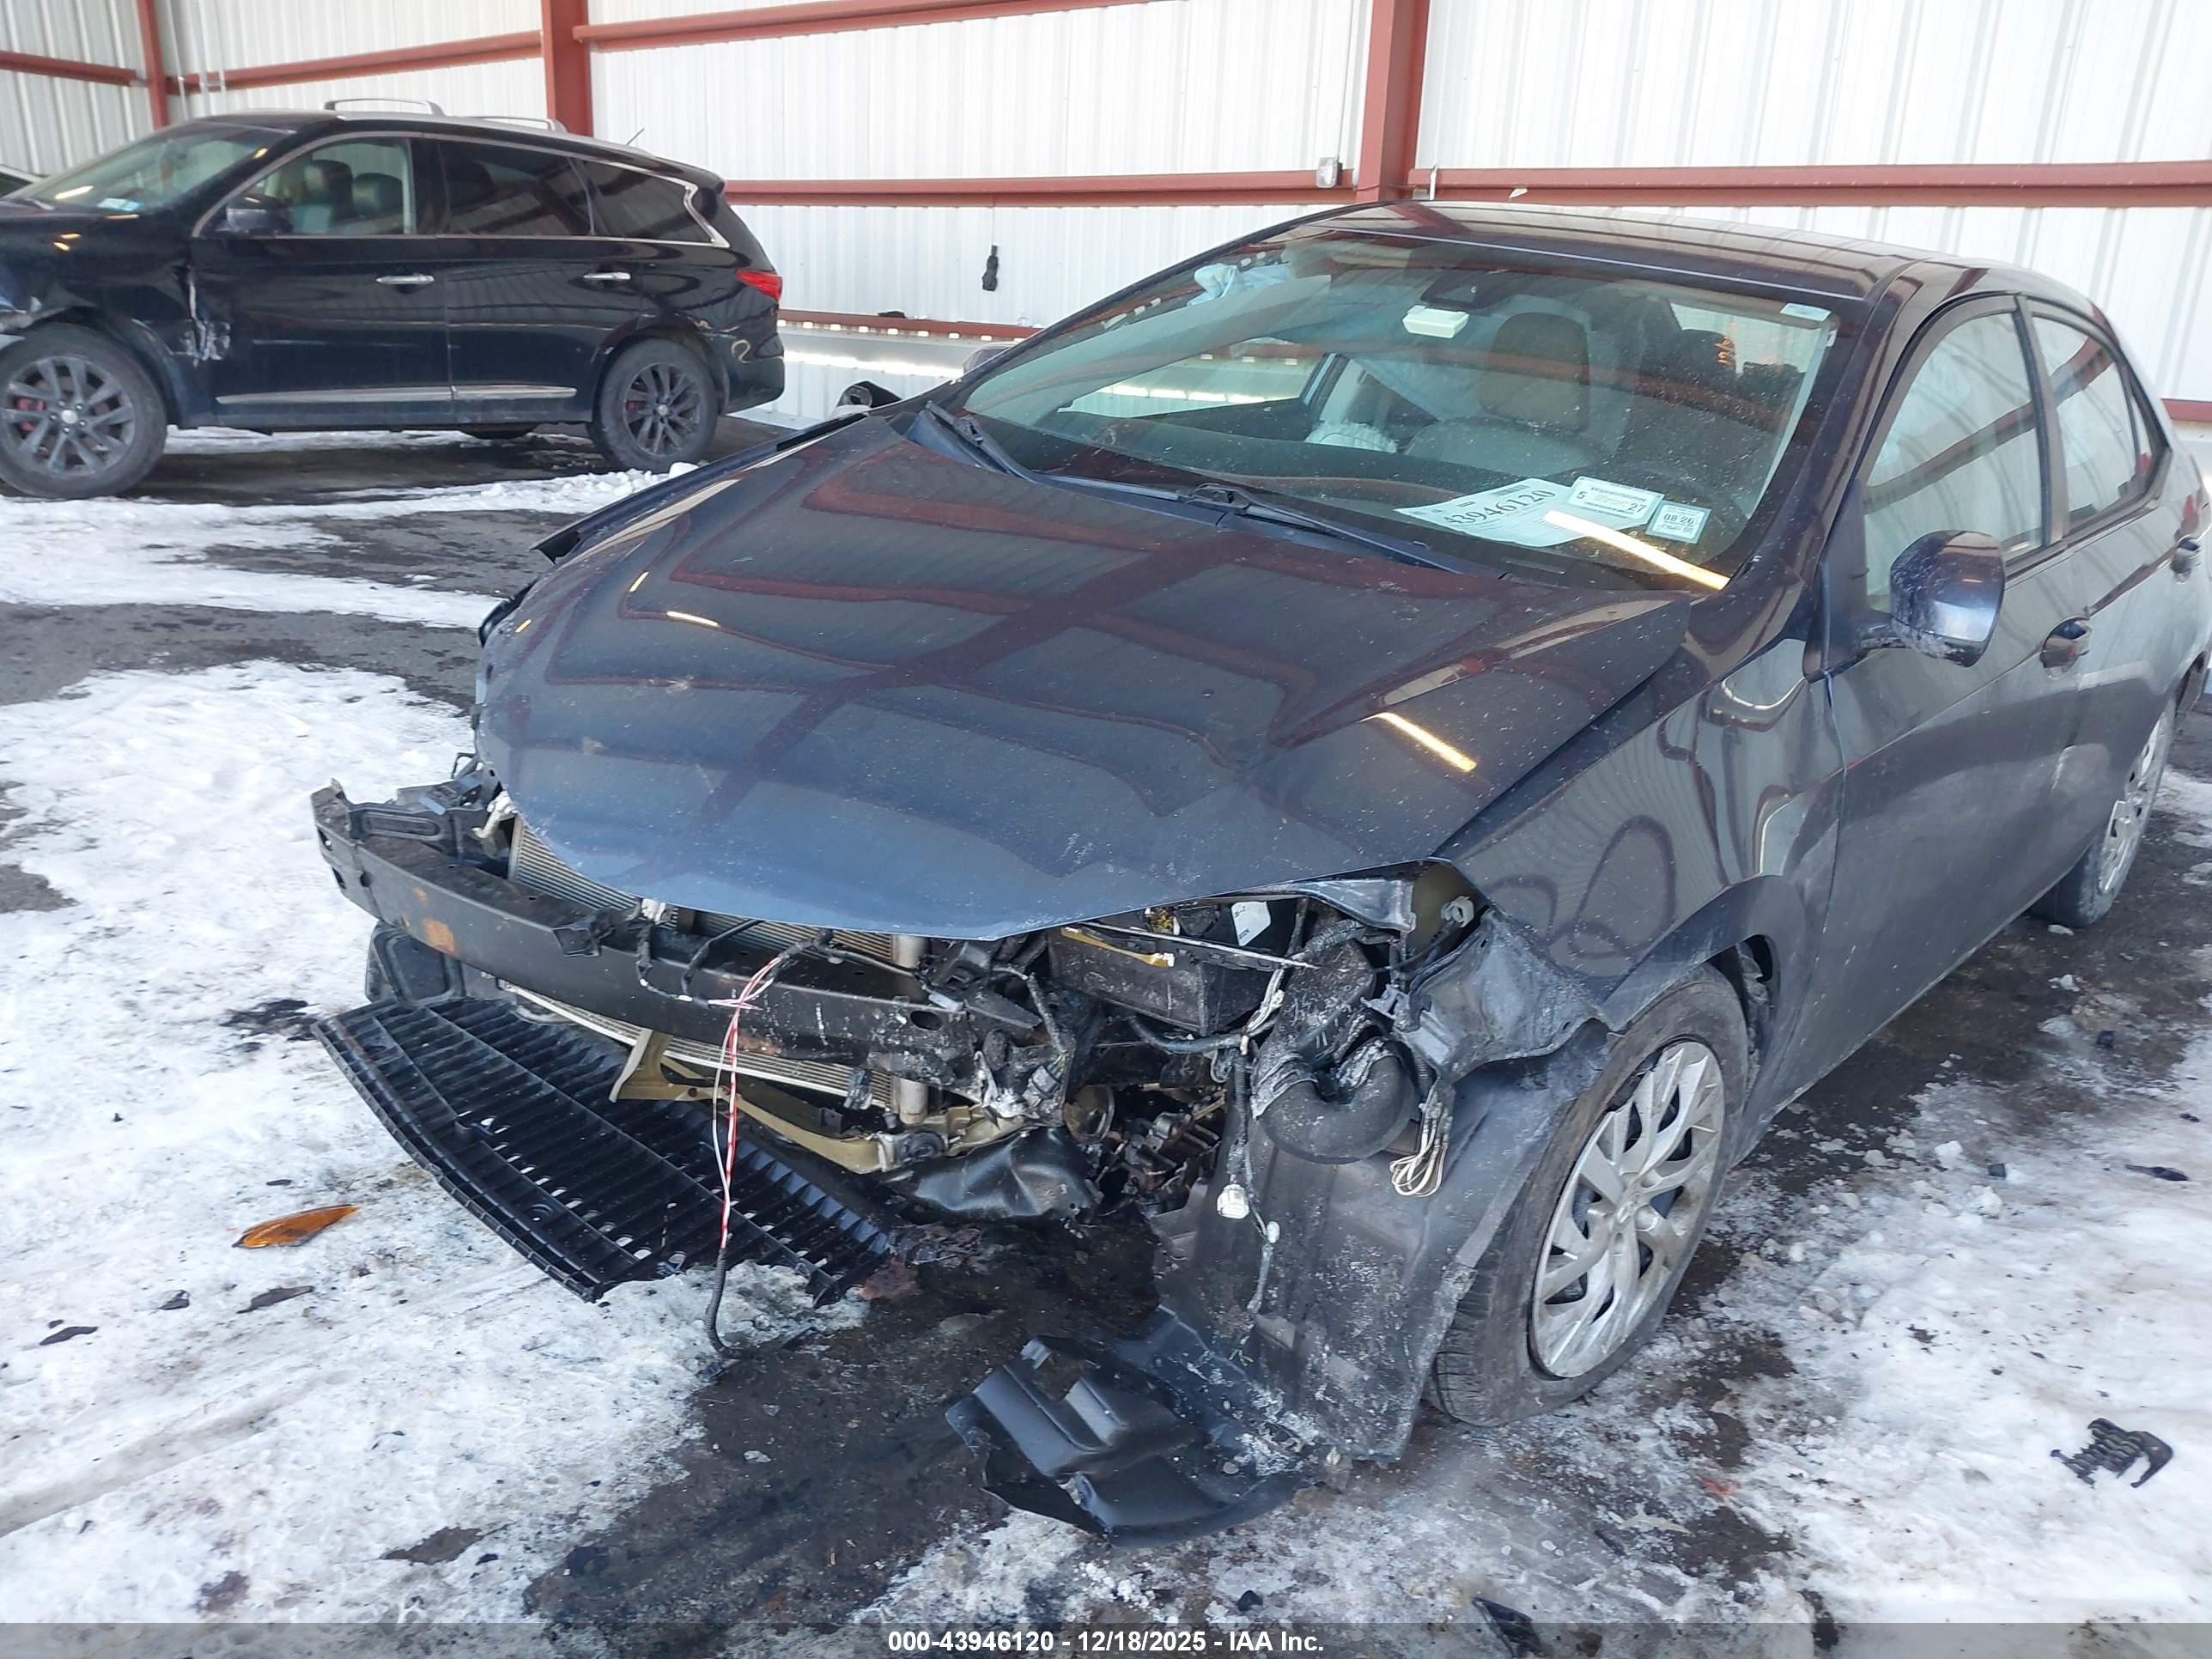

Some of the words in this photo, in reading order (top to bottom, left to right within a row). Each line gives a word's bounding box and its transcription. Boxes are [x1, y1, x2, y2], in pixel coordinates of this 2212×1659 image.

[1443, 489, 1556, 524] 43946120
[1577, 491, 1587, 500] 5
[1627, 502, 1649, 514] 27
[1663, 513, 1677, 522] 08
[1680, 515, 1697, 526] 26
